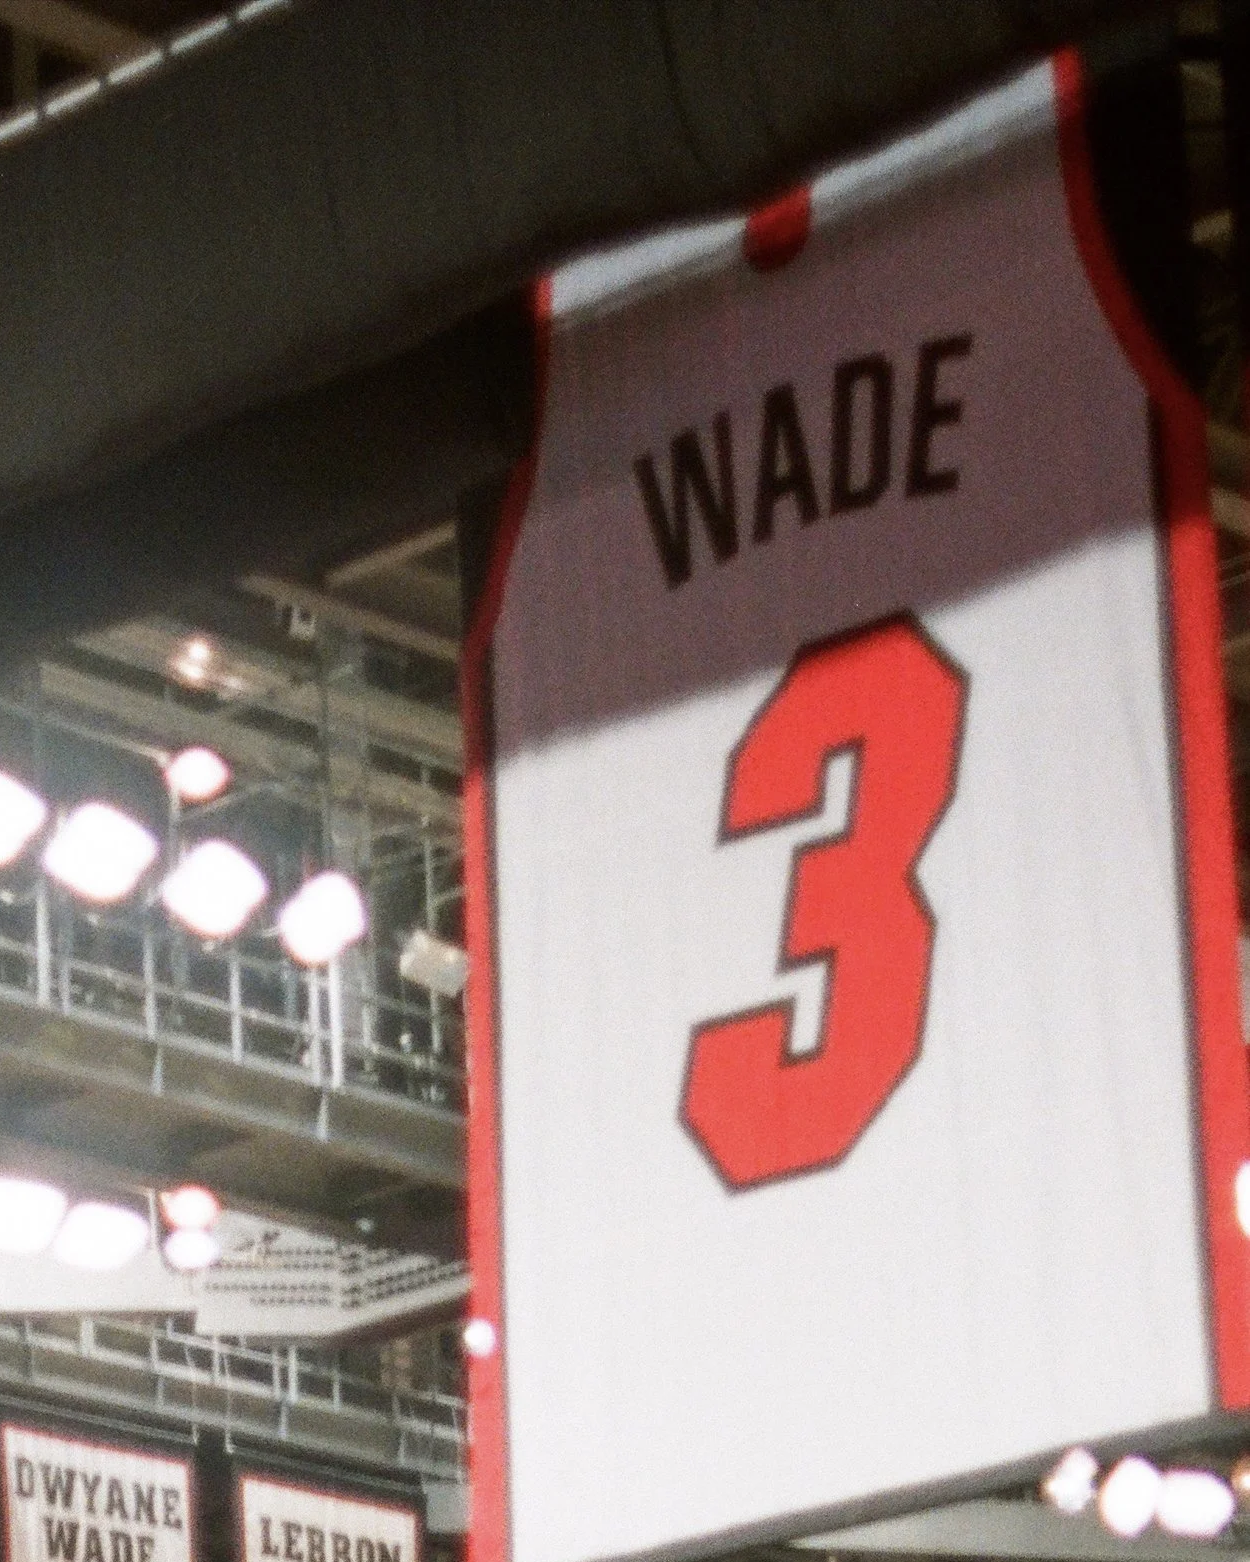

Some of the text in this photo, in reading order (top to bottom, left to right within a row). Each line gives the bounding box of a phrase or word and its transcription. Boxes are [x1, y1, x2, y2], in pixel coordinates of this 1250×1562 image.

[634, 333, 974, 591] WADE
[679, 611, 971, 1197] 3
[14, 1456, 183, 1531] DWYANE
